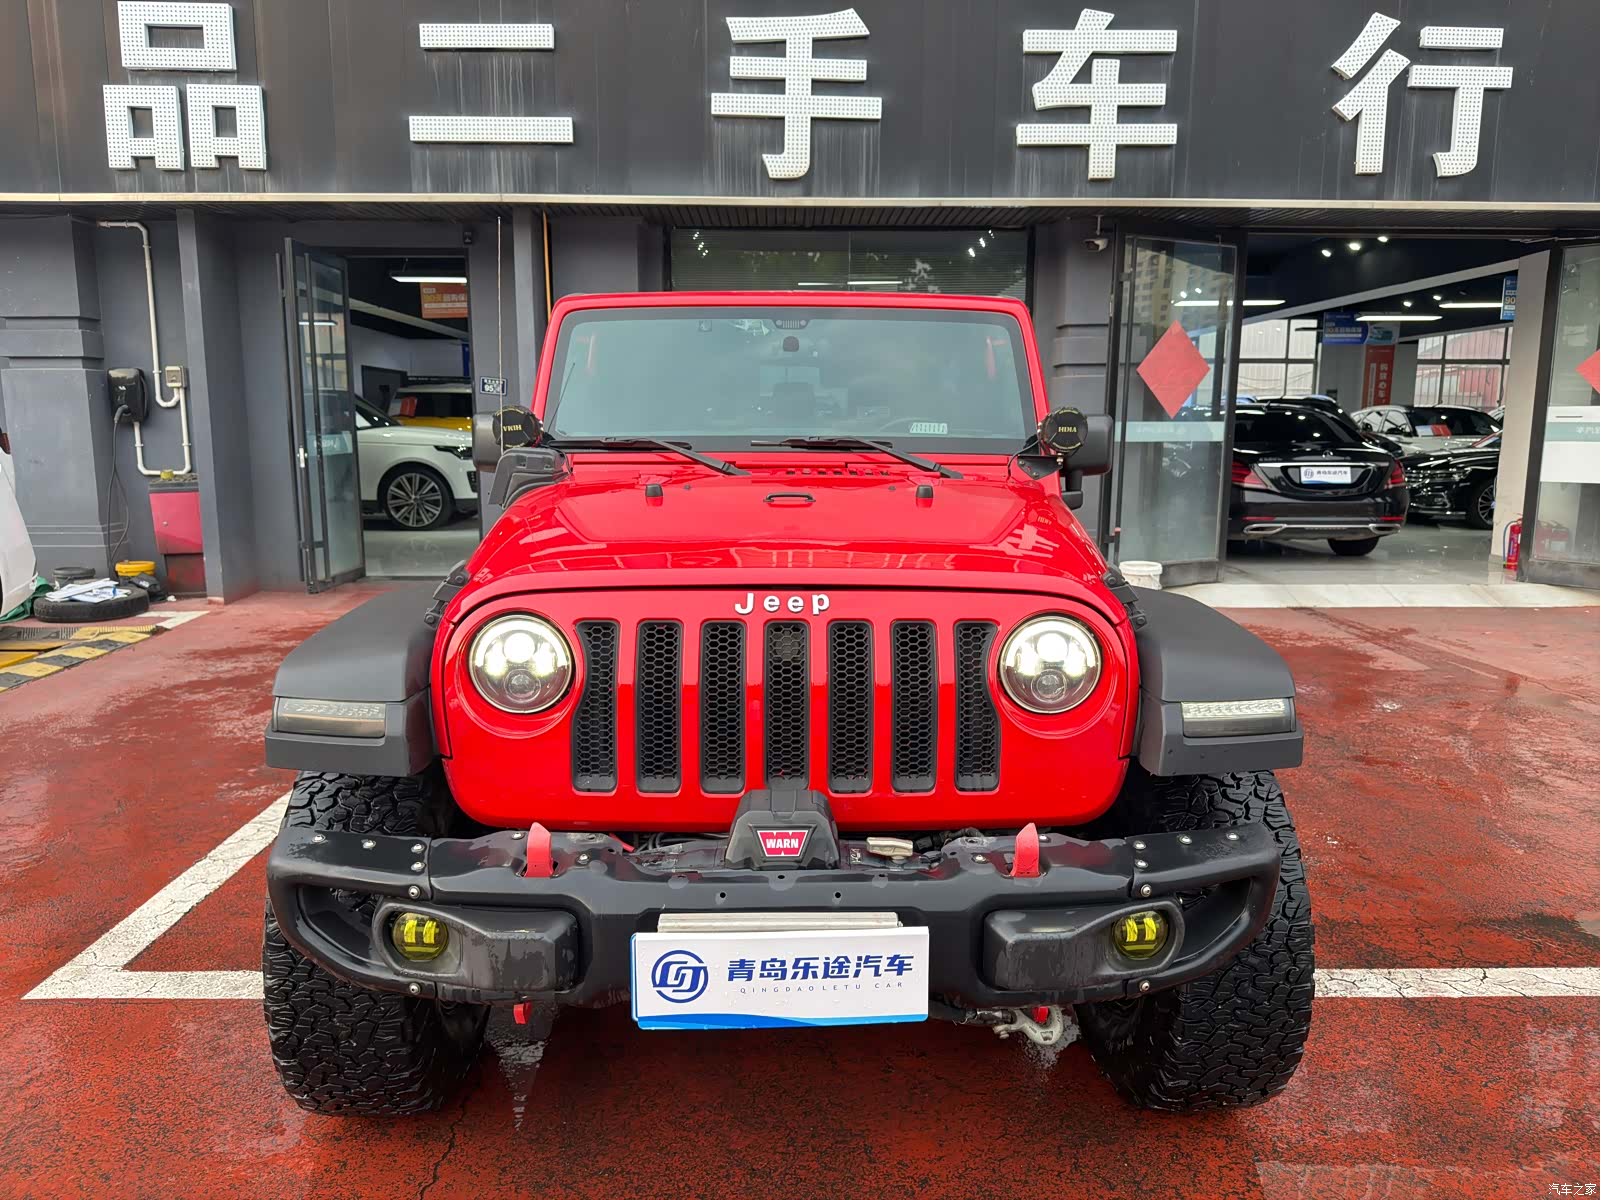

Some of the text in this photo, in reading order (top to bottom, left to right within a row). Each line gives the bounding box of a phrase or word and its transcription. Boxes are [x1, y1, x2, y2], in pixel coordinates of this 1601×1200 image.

[735, 593, 830, 615] Jeep
[766, 838, 800, 849] WARN
[728, 954, 914, 982] 青岛乐途汽车
